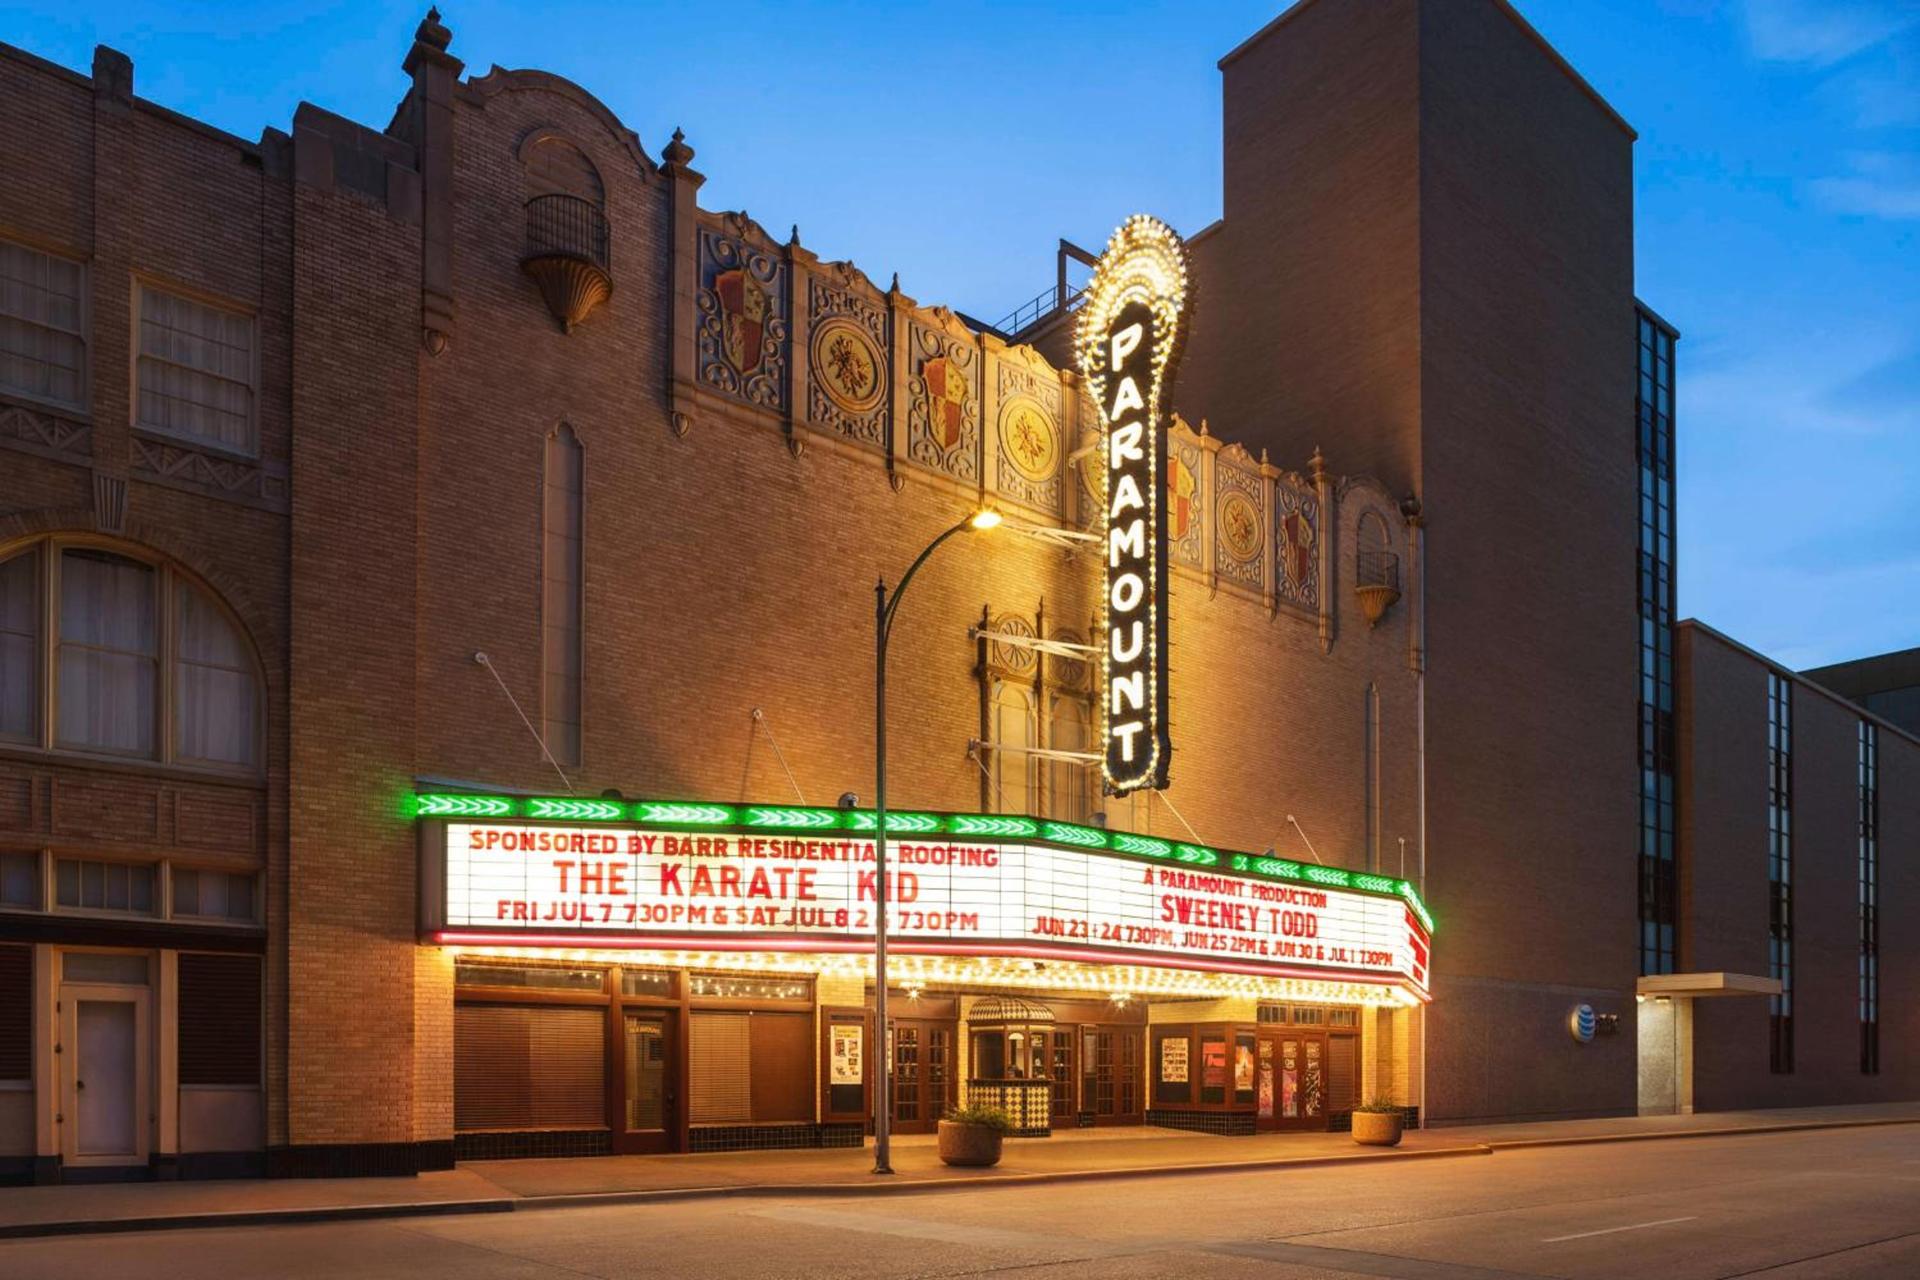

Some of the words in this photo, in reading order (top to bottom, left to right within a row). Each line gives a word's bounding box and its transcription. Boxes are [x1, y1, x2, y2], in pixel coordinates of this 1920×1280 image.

[1110, 322, 1145, 762] PARAMOUNT
[469, 829, 618, 854] SPONSORED
[627, 835, 657, 855] BY
[663, 836, 729, 857] BARR
[738, 838, 892, 863] RESIDENTIA
[899, 844, 998, 867] ROOFING
[553, 860, 629, 896] THE
[660, 862, 818, 901] KARATE
[857, 869, 919, 903] KID
[1143, 867, 1154, 885] A
[1160, 869, 1245, 896] PARAMOUNT
[1252, 884, 1327, 908] PRODUCTION
[497, 900, 537, 921] FRI
[543, 902, 594, 923] JUL
[601, 903, 612, 922] 7
[623, 904, 707, 925] 730PM
[712, 906, 728, 925] &
[736, 906, 780, 926] SAT
[784, 907, 831, 927] JUL
[835, 908, 848, 927] 8
[855, 908, 869, 928] 2
[898, 911, 979, 931] 730PM
[1161, 894, 1260, 932] SWEENEY
[1269, 908, 1318, 938] TODD
[1032, 916, 1065, 937] JUN
[1069, 918, 1088, 938] 23
[1101, 922, 1121, 941] 24
[1181, 931, 1208, 950] JUN
[1211, 934, 1227, 951] 25
[1230, 937, 1257, 954] 2PM
[1272, 941, 1297, 958] JUN
[1299, 943, 1313, 960] 30
[1328, 948, 1347, 963] JUL
[1360, 949, 1393, 966] 730PM
